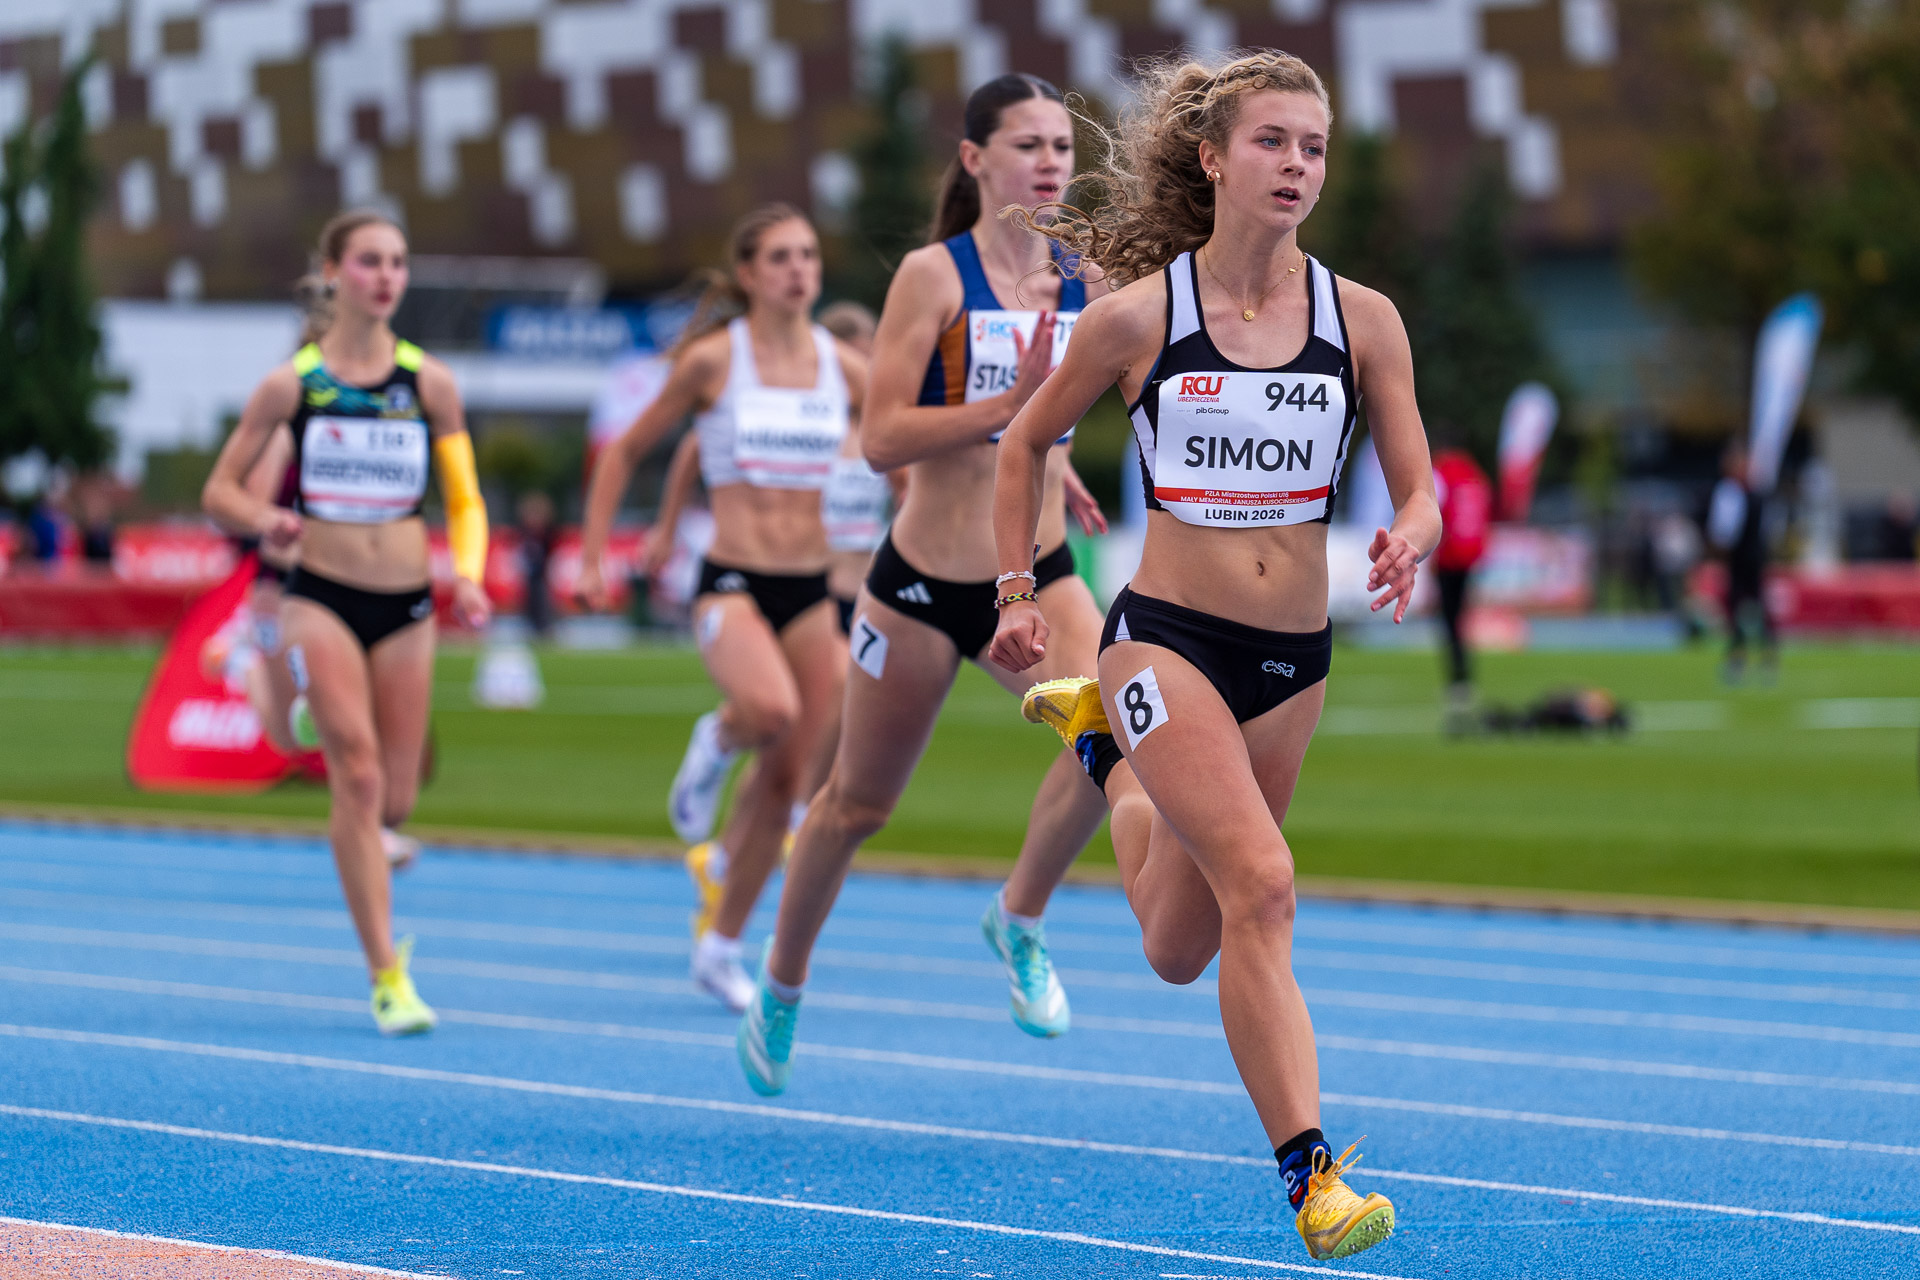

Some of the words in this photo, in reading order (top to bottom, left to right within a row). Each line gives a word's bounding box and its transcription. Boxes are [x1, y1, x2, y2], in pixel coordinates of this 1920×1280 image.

[1178, 375, 1225, 396] RCU
[1264, 381, 1330, 413] 944
[1183, 435, 1314, 472] SIMON
[1180, 495, 1198, 503] MAŁY
[1198, 497, 1232, 505] MEMORIAŁ
[1262, 496, 1309, 505] KUSOCIŃSKIEGO
[1221, 491, 1260, 499] Mistrzostwa
[1205, 508, 1249, 521] LUBIN
[1251, 508, 1285, 521] 2026
[859, 623, 879, 662] 7
[1124, 681, 1153, 735] 8
